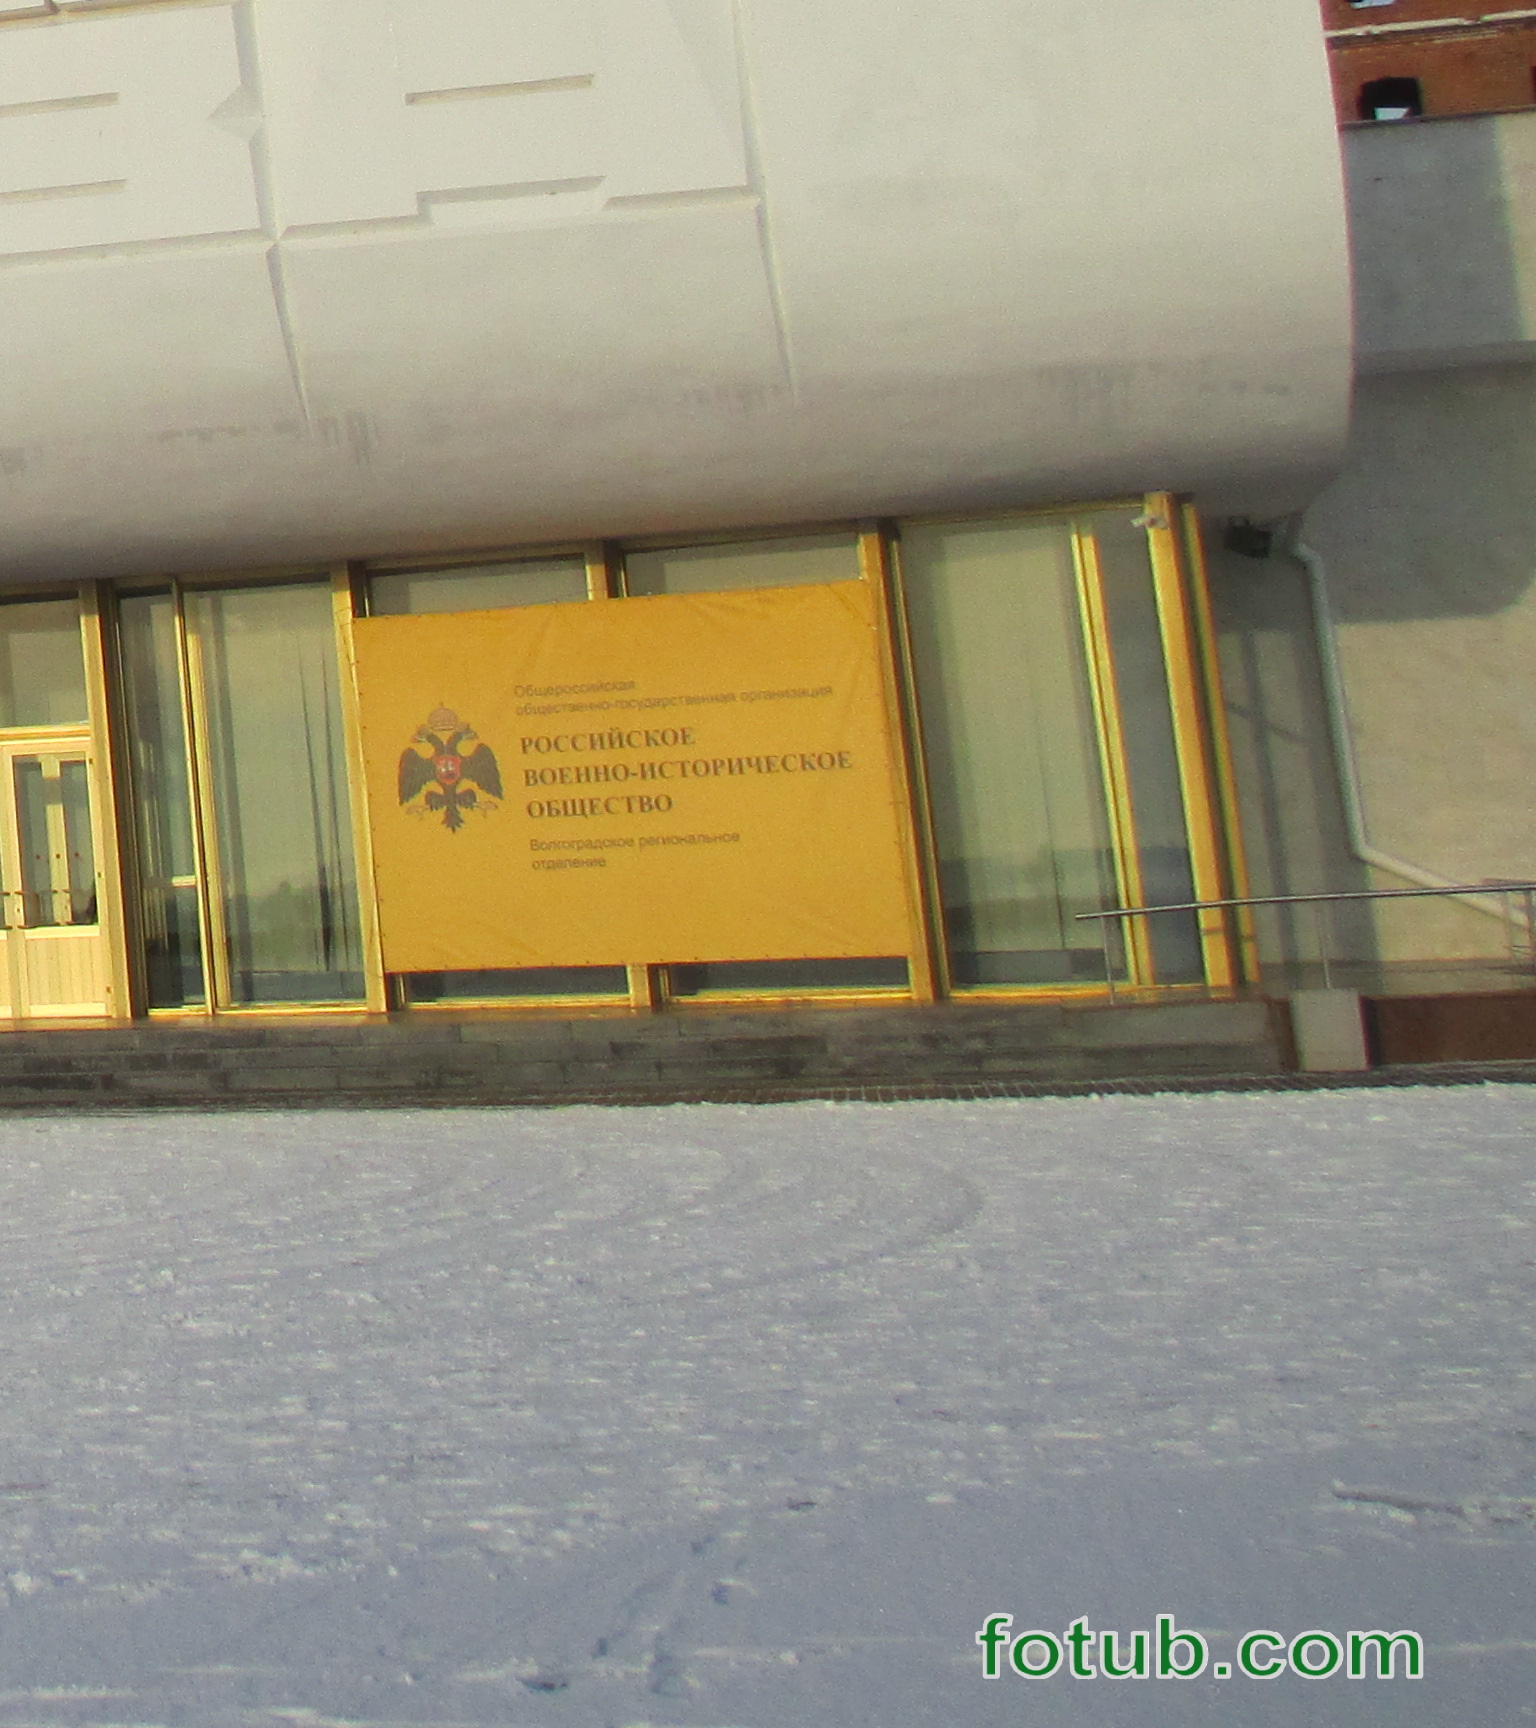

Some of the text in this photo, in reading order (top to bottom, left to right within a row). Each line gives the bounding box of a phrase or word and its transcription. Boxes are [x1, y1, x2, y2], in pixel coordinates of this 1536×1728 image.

[514, 678, 636, 698] Общероссийская
[516, 685, 834, 717] общественно-государственная организация
[520, 726, 696, 756] РОССИЙСКОЕ
[524, 750, 853, 787] ВОЕННО-ИСТОРИЧЕСКОЕ
[527, 793, 673, 819] ОБЩЕСТВО
[530, 831, 740, 854] Волгоградское региональное
[532, 855, 607, 871] отделение
